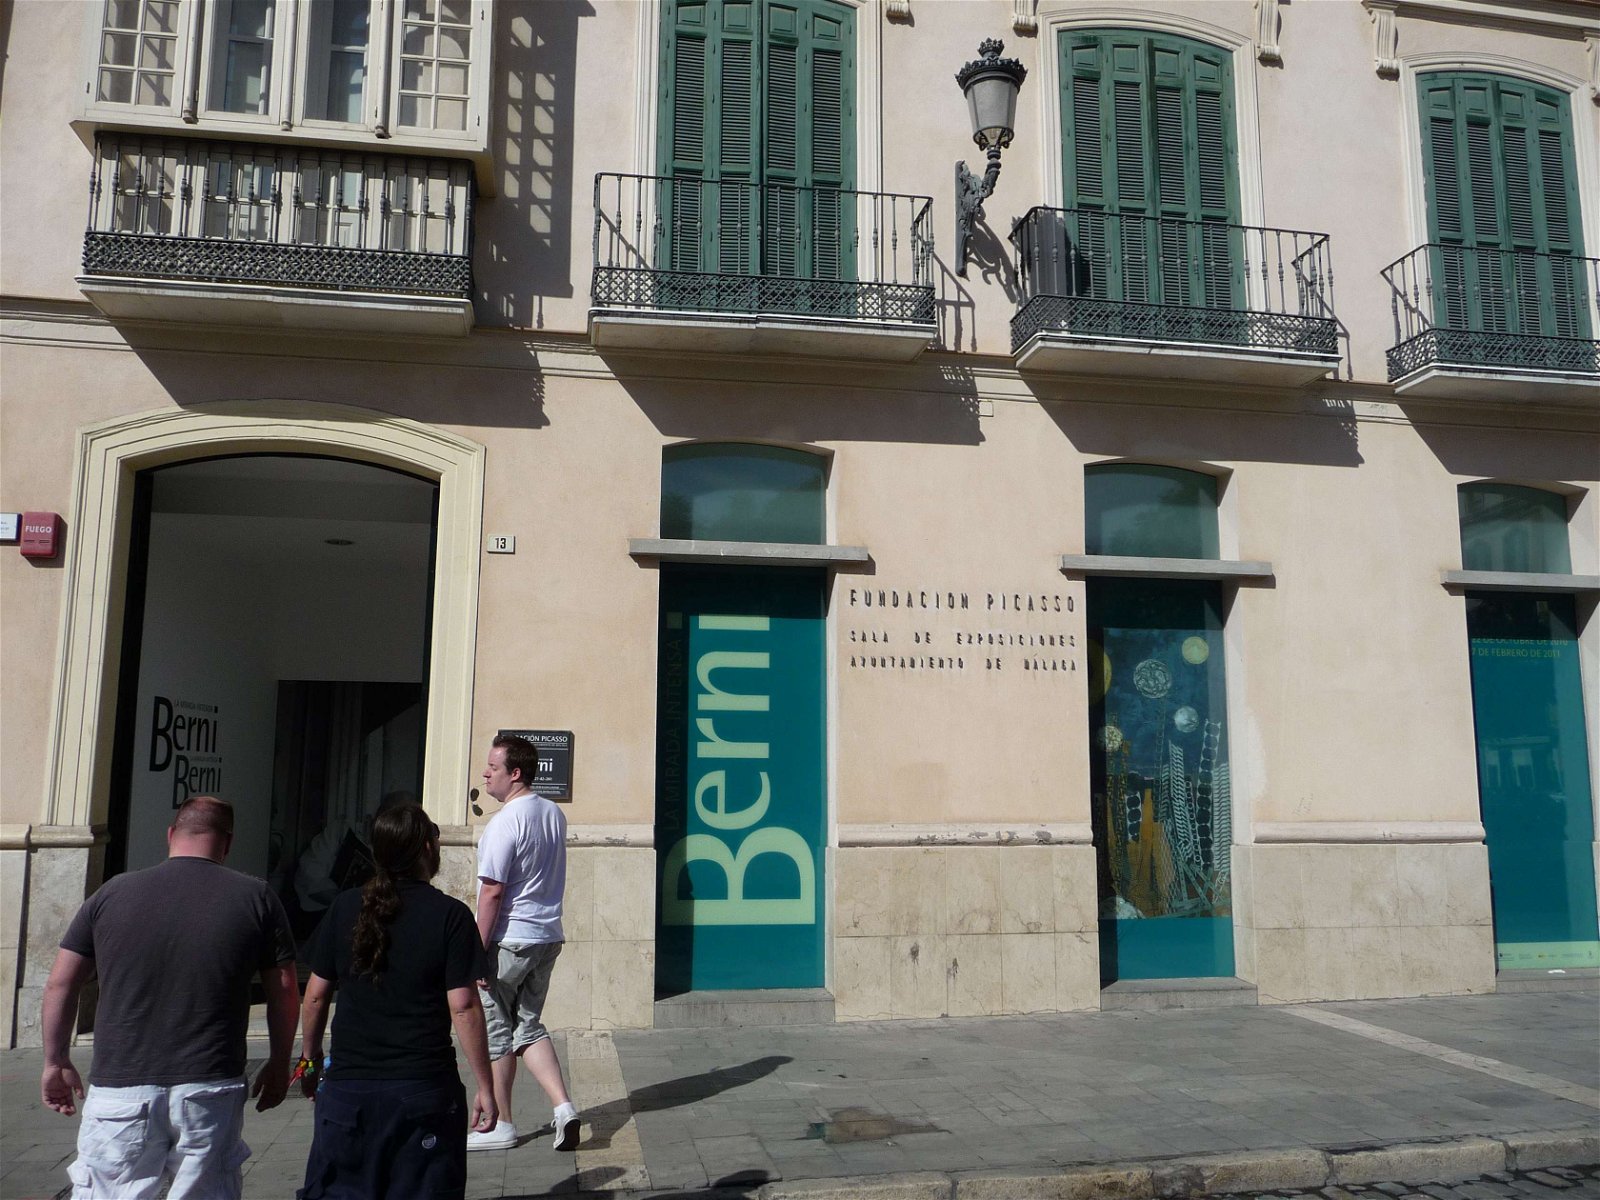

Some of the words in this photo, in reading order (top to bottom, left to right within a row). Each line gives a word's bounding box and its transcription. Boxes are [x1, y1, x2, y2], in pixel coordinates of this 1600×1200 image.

[25, 525, 52, 533] FUEGO
[495, 537, 507, 549] 13
[850, 589, 969, 609] FUNDACION
[986, 592, 1074, 612] PICASSO
[850, 630, 889, 643] SALA
[914, 631, 931, 644] DE
[956, 632, 1075, 647] EXPOSICIONES
[1478, 648, 1489, 657] DE
[1491, 648, 1529, 657] FEBRERO
[1530, 649, 1542, 657] DE
[1543, 649, 1560, 658] 2011
[850, 656, 964, 669] AYUNTAMIENTO
[985, 658, 1001, 670] DE
[149, 696, 218, 772] Berni
[662, 612, 815, 925] Berni
[172, 754, 222, 809] Berni
